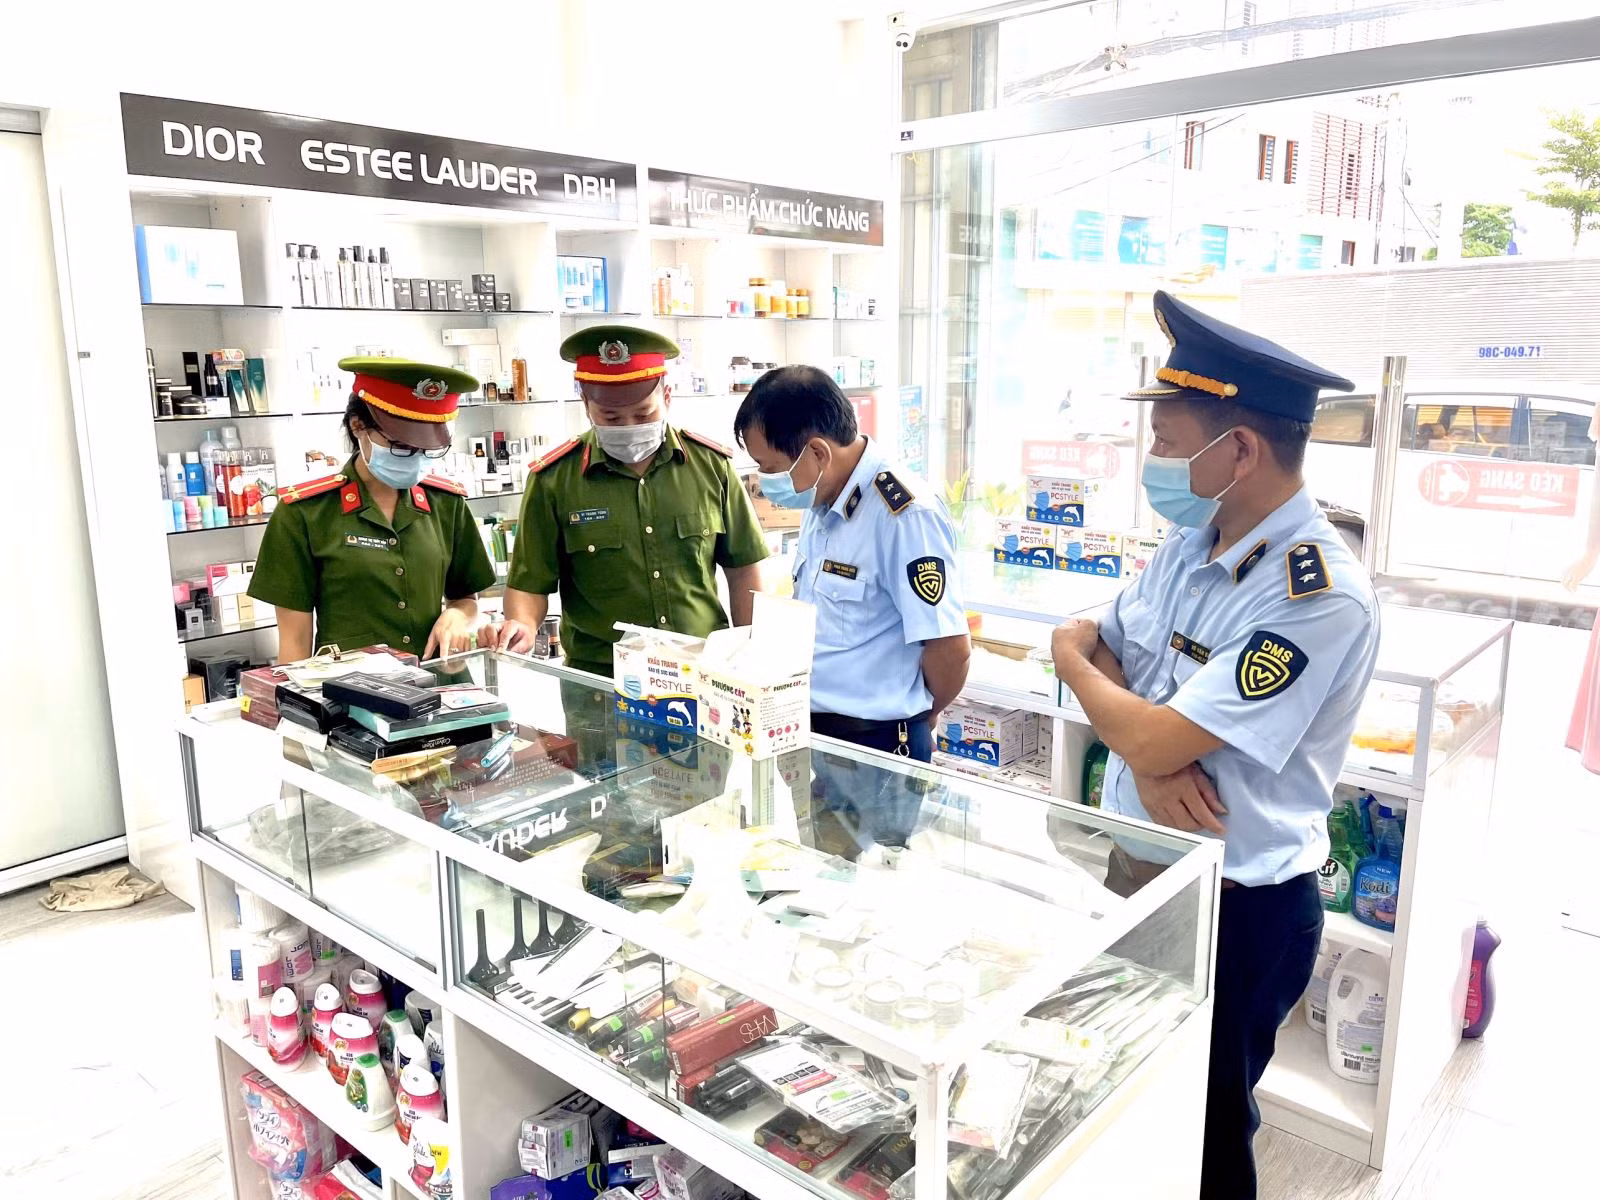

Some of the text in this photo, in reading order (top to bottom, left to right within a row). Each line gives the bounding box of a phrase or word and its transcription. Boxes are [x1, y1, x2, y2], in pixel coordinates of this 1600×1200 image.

[162, 120, 266, 166] DIOR
[300, 139, 538, 197] ESTEE LAUDER
[722, 187, 776, 222] PHẨM
[779, 198, 823, 228] CHỨC
[826, 204, 869, 232] NĂNG
[1478, 345, 1541, 358] 98C-049.71
[1050, 492, 1079, 502] PCSTYLE
[1020, 535, 1049, 546] PCSTYLE
[1083, 542, 1115, 553] PCSTYLE
[1260, 639, 1294, 664] DMS
[650, 677, 693, 694] PCSTYLE
[963, 725, 994, 739] PCSTYLE
[1360, 876, 1390, 894] Kodi
